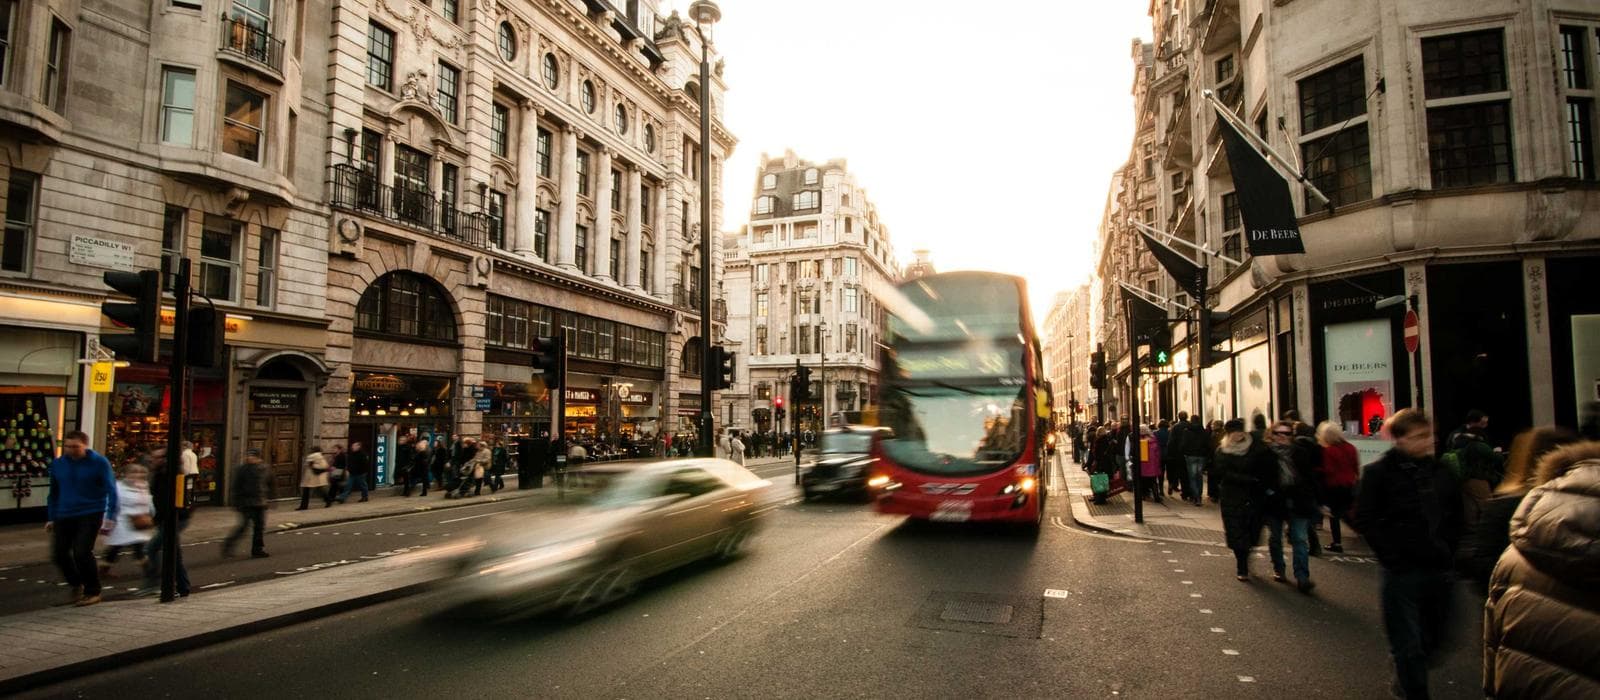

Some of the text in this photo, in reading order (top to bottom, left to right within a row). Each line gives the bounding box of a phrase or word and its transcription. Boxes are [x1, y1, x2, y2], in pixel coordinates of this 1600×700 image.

[75, 236, 119, 249] PICCADILLY
[1352, 361, 1388, 370] BEERS
[94, 369, 108, 382] itsu
[377, 435, 385, 483] MONEY
